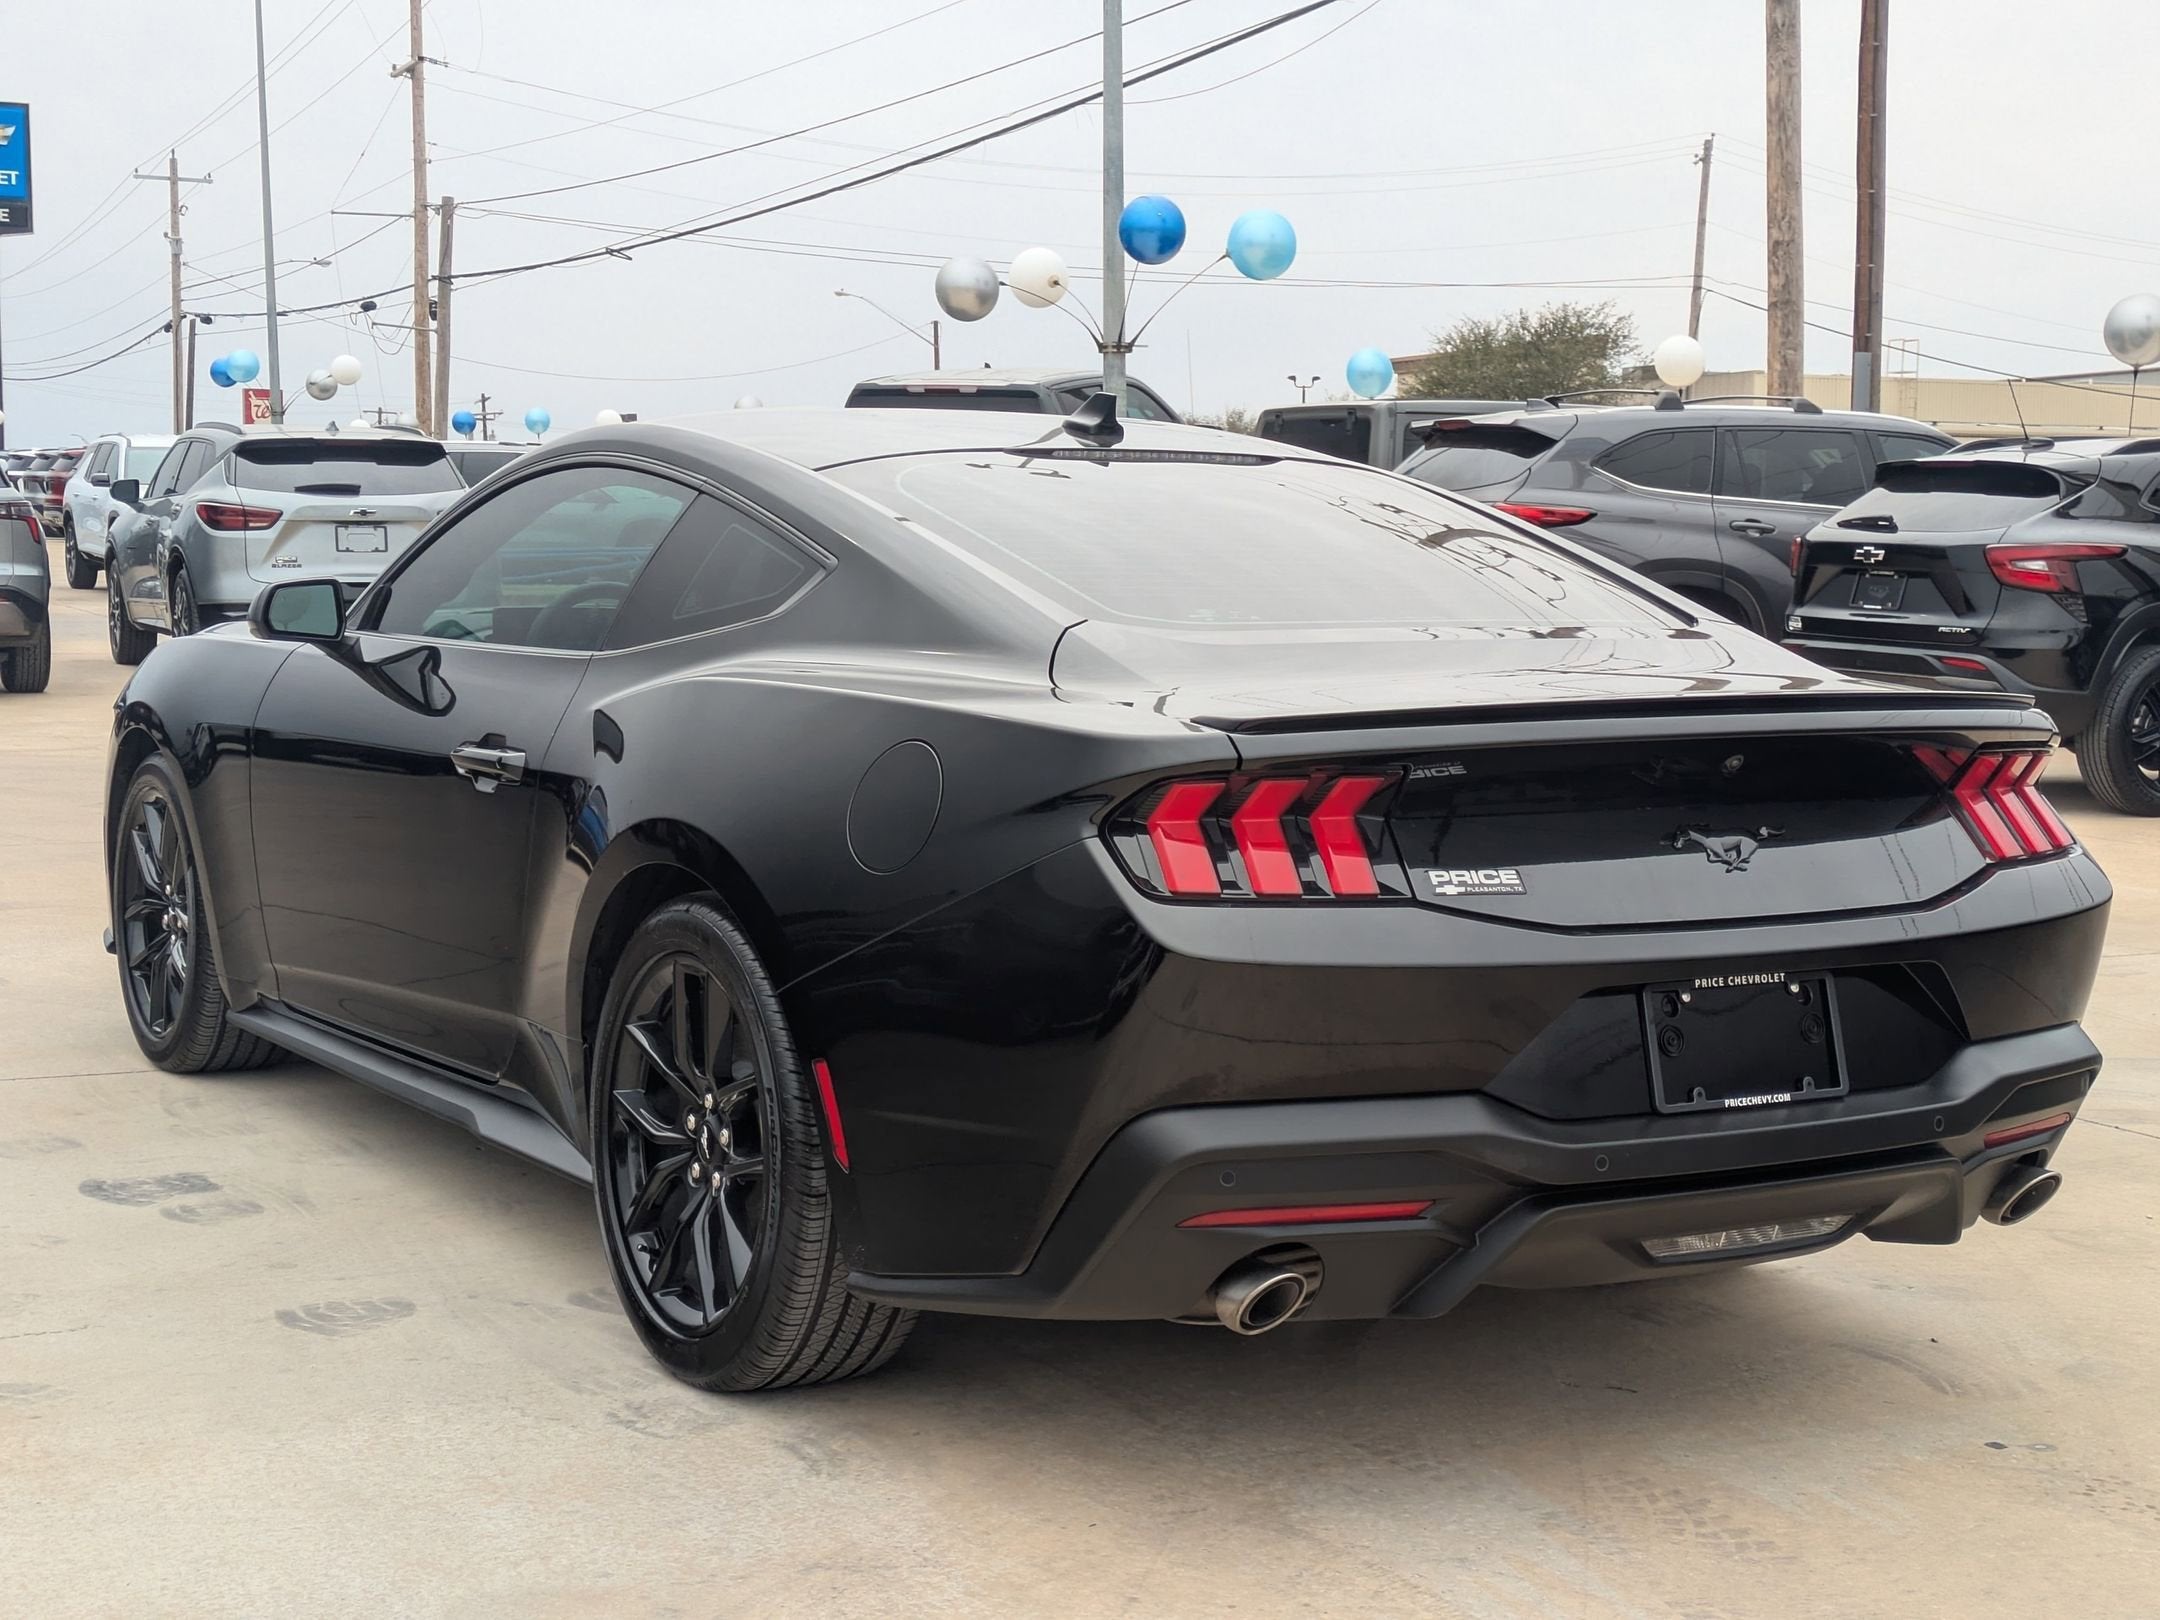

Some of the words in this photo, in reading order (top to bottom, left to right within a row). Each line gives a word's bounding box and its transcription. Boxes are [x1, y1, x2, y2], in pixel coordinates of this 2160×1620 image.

[1428, 869, 1521, 885] PRICE
[1695, 977, 1724, 989] PRICE
[1728, 972, 1785, 986] CHEVROLET
[1724, 1093, 1791, 1108] PRICECHEVY.COM
